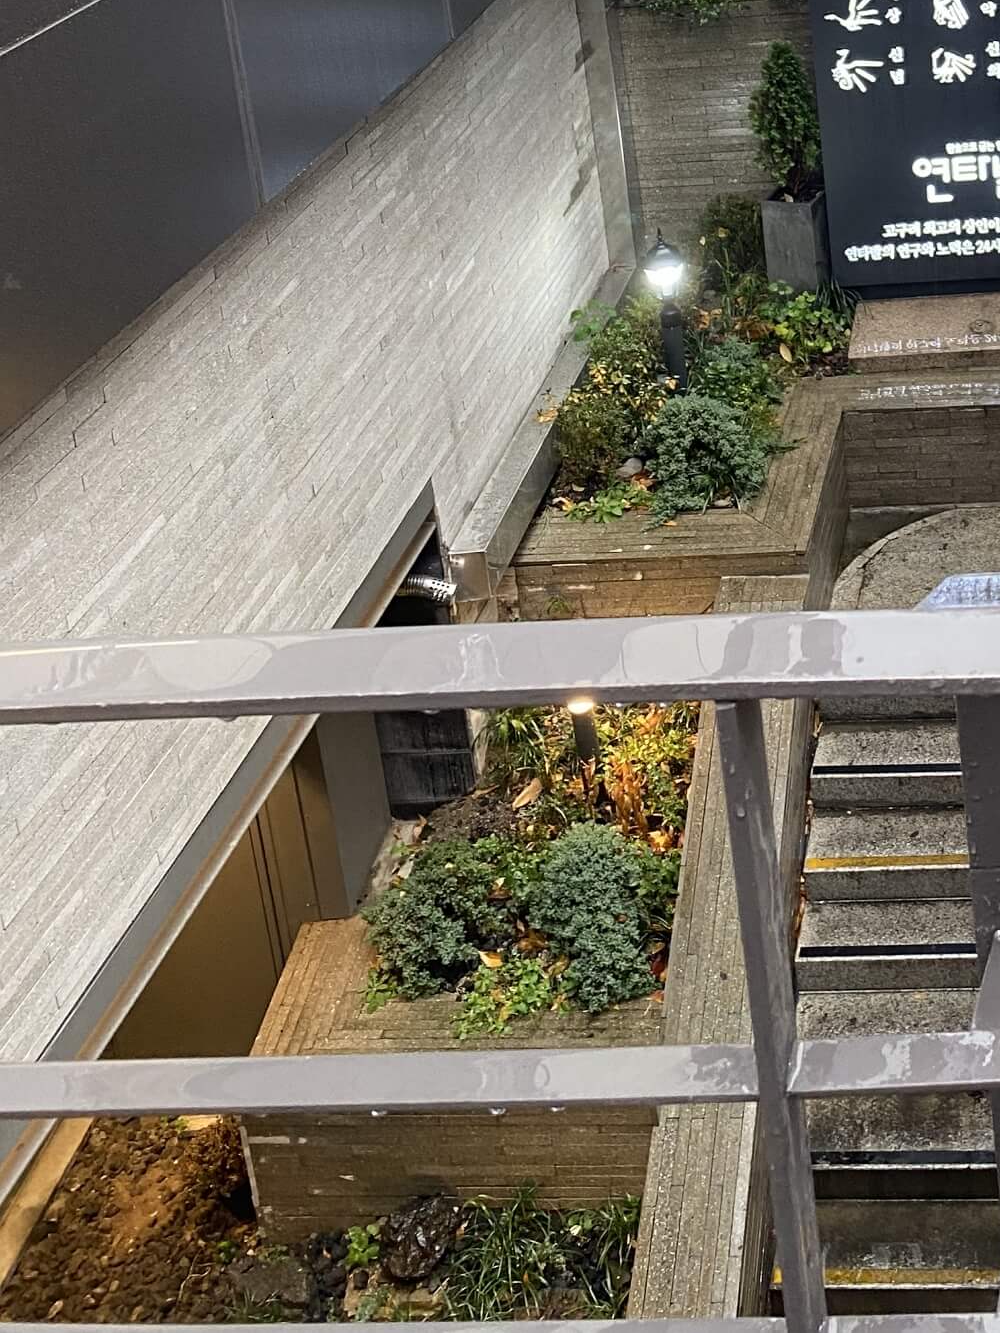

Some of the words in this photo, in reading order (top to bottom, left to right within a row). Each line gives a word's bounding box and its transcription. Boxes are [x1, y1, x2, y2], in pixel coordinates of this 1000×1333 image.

[881, 220, 922, 239] 고구려
[923, 218, 962, 237] 최고의
[844, 243, 896, 263] 연타발의
[896, 240, 936, 260] 연구와
[936, 238, 975, 257] 노력은
